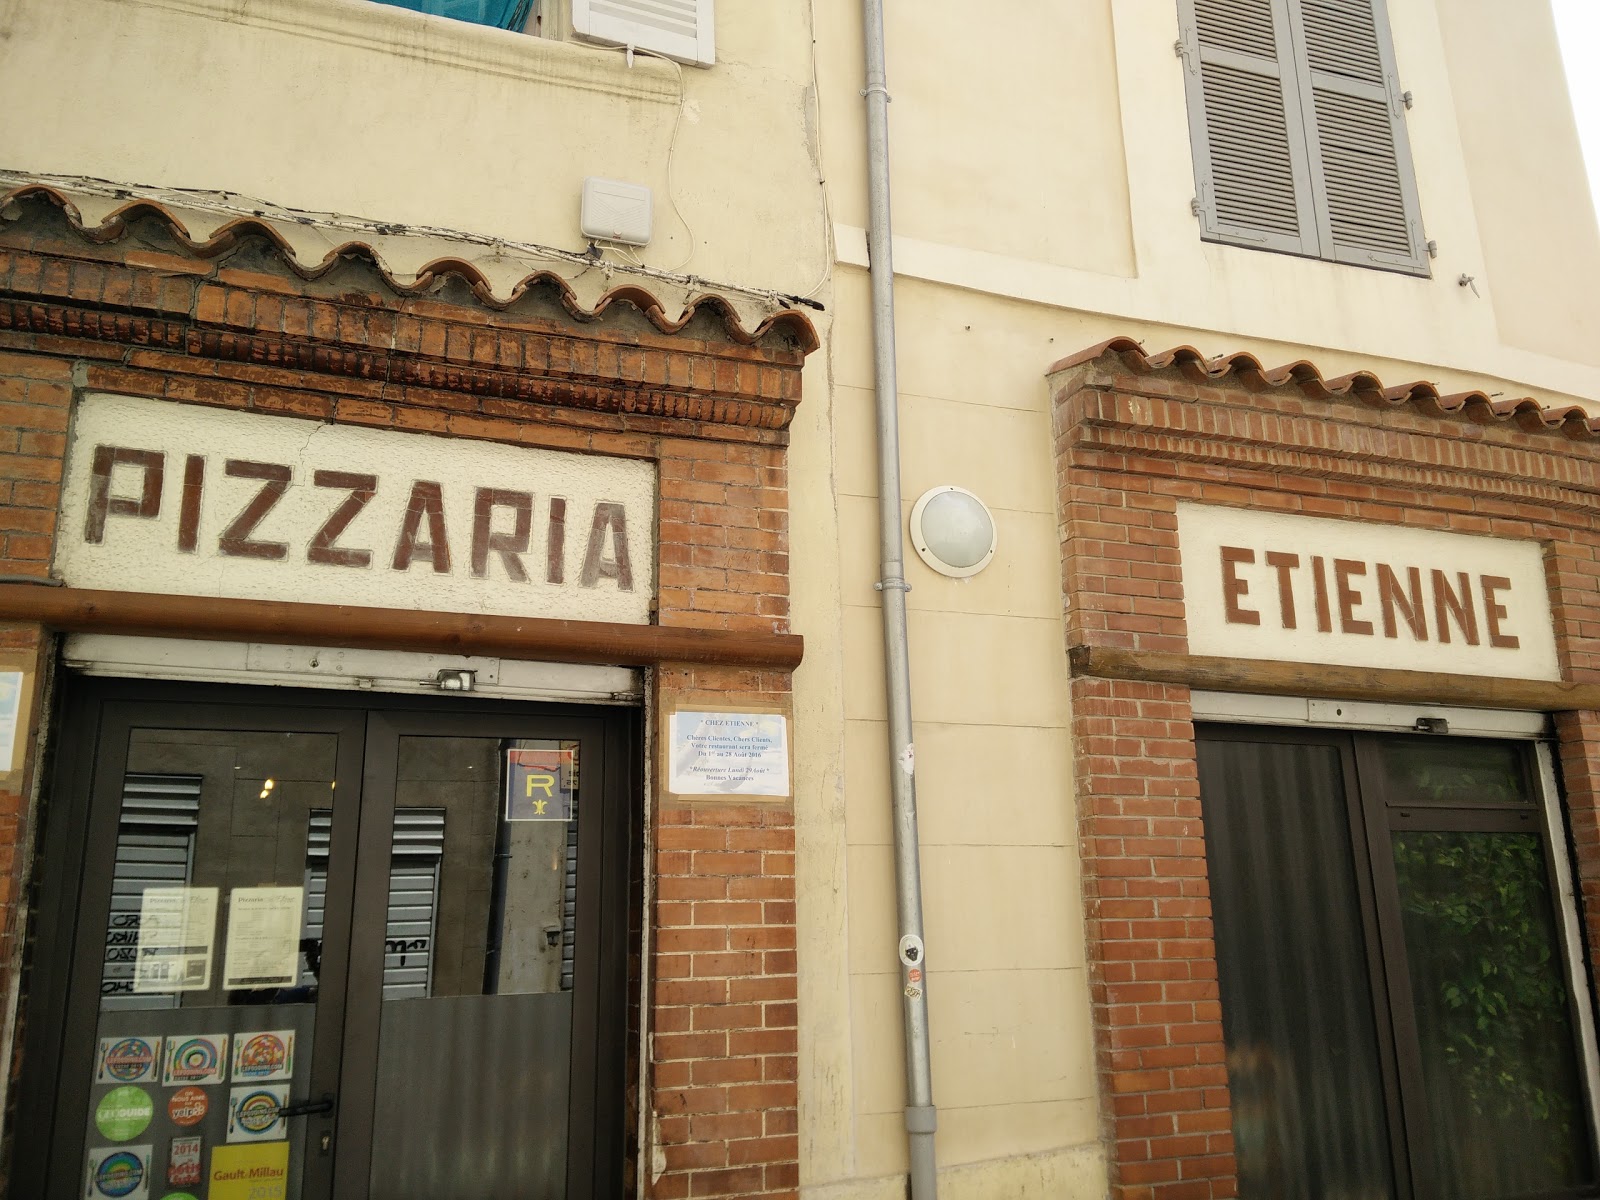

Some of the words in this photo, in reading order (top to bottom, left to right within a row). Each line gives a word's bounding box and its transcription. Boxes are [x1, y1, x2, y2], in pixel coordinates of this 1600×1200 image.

[84, 444, 635, 592] PIZZARIA
[1220, 545, 1520, 649] ETIENNE
[526, 774, 556, 797] R
[172, 1107, 194, 1119] yelp
[174, 1143, 199, 1155] 2014
[213, 1169, 245, 1181] Gault
[248, 1166, 284, 1179] Millau
